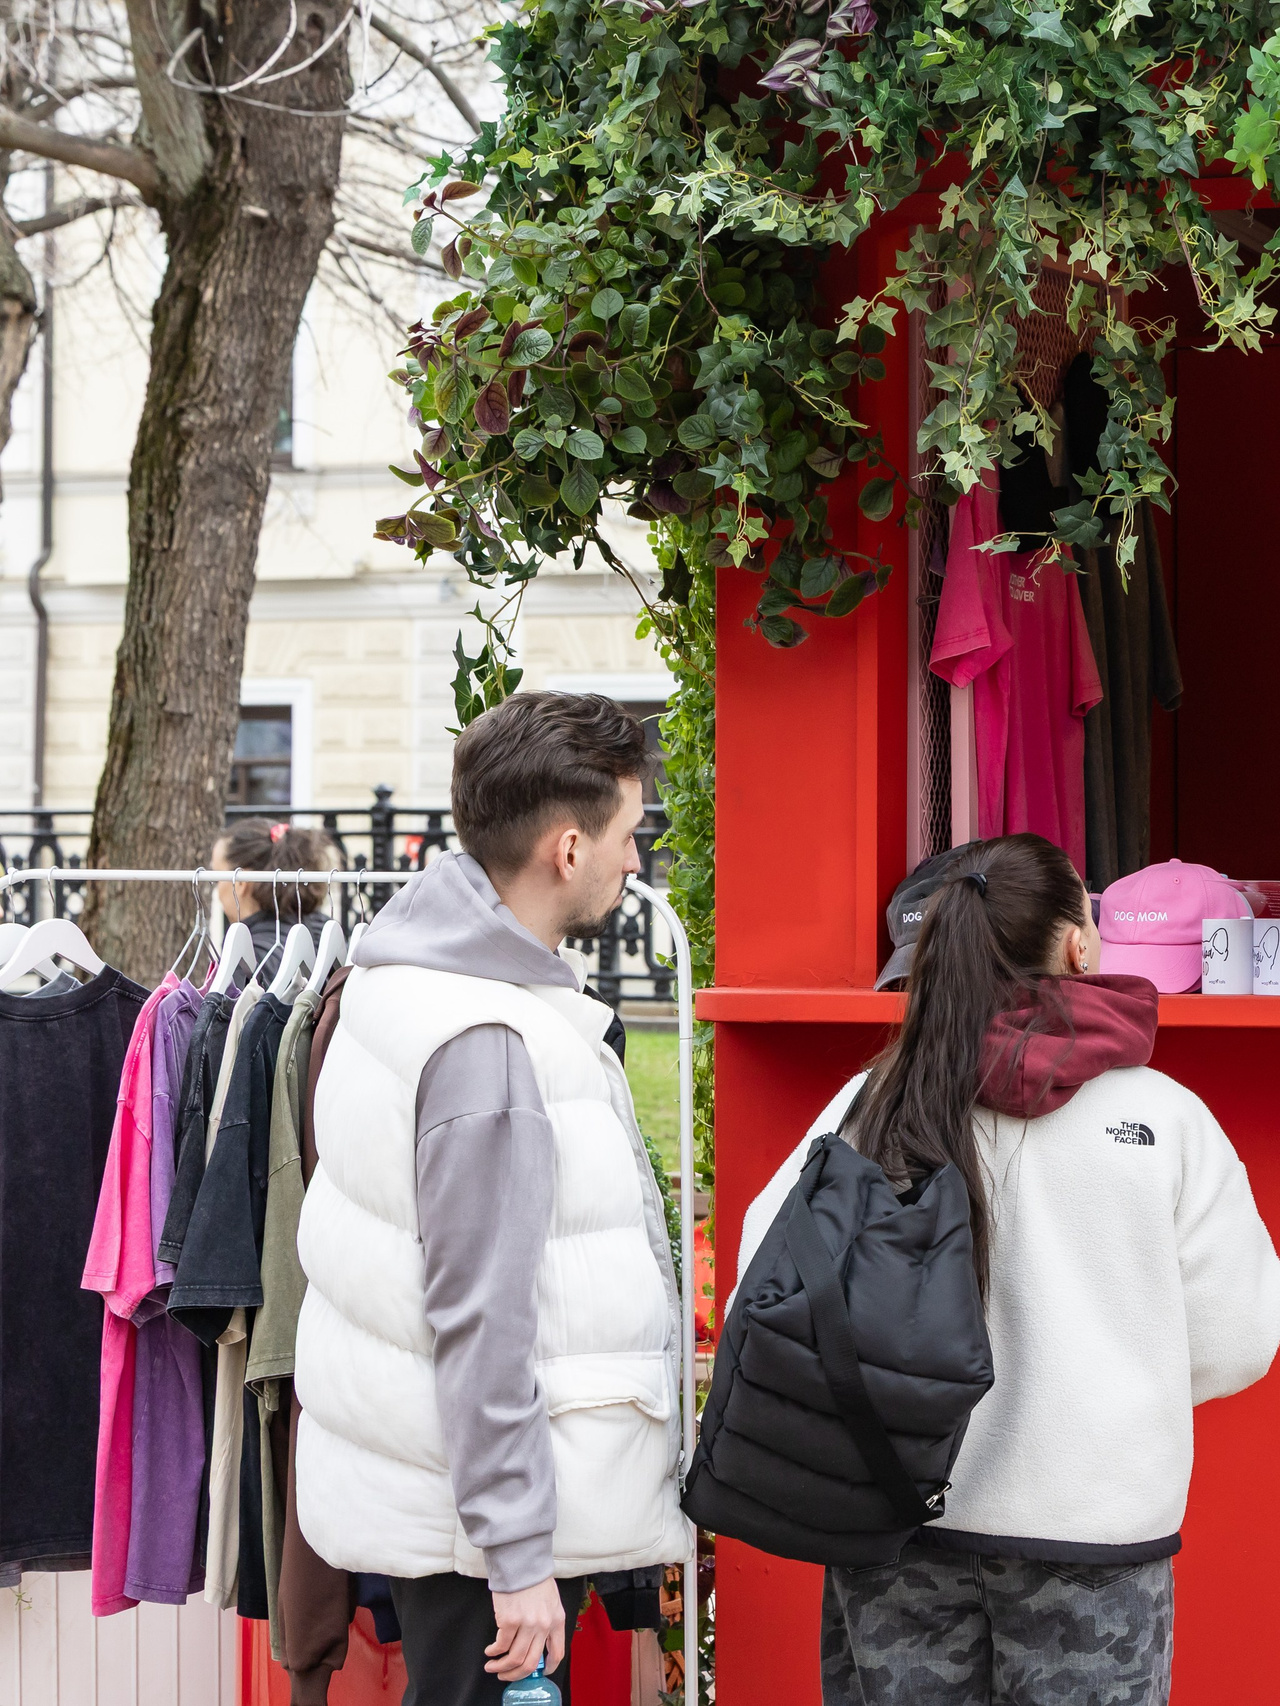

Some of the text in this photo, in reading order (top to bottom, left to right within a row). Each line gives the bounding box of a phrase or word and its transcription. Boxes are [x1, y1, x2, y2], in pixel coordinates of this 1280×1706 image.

[902, 911, 922, 923] DOG
[1114, 911, 1168, 922] DOG MOM
[1120, 1121, 1139, 1131] THE
[1105, 1127, 1138, 1137] NORTH
[1114, 1136, 1138, 1145] FACE
